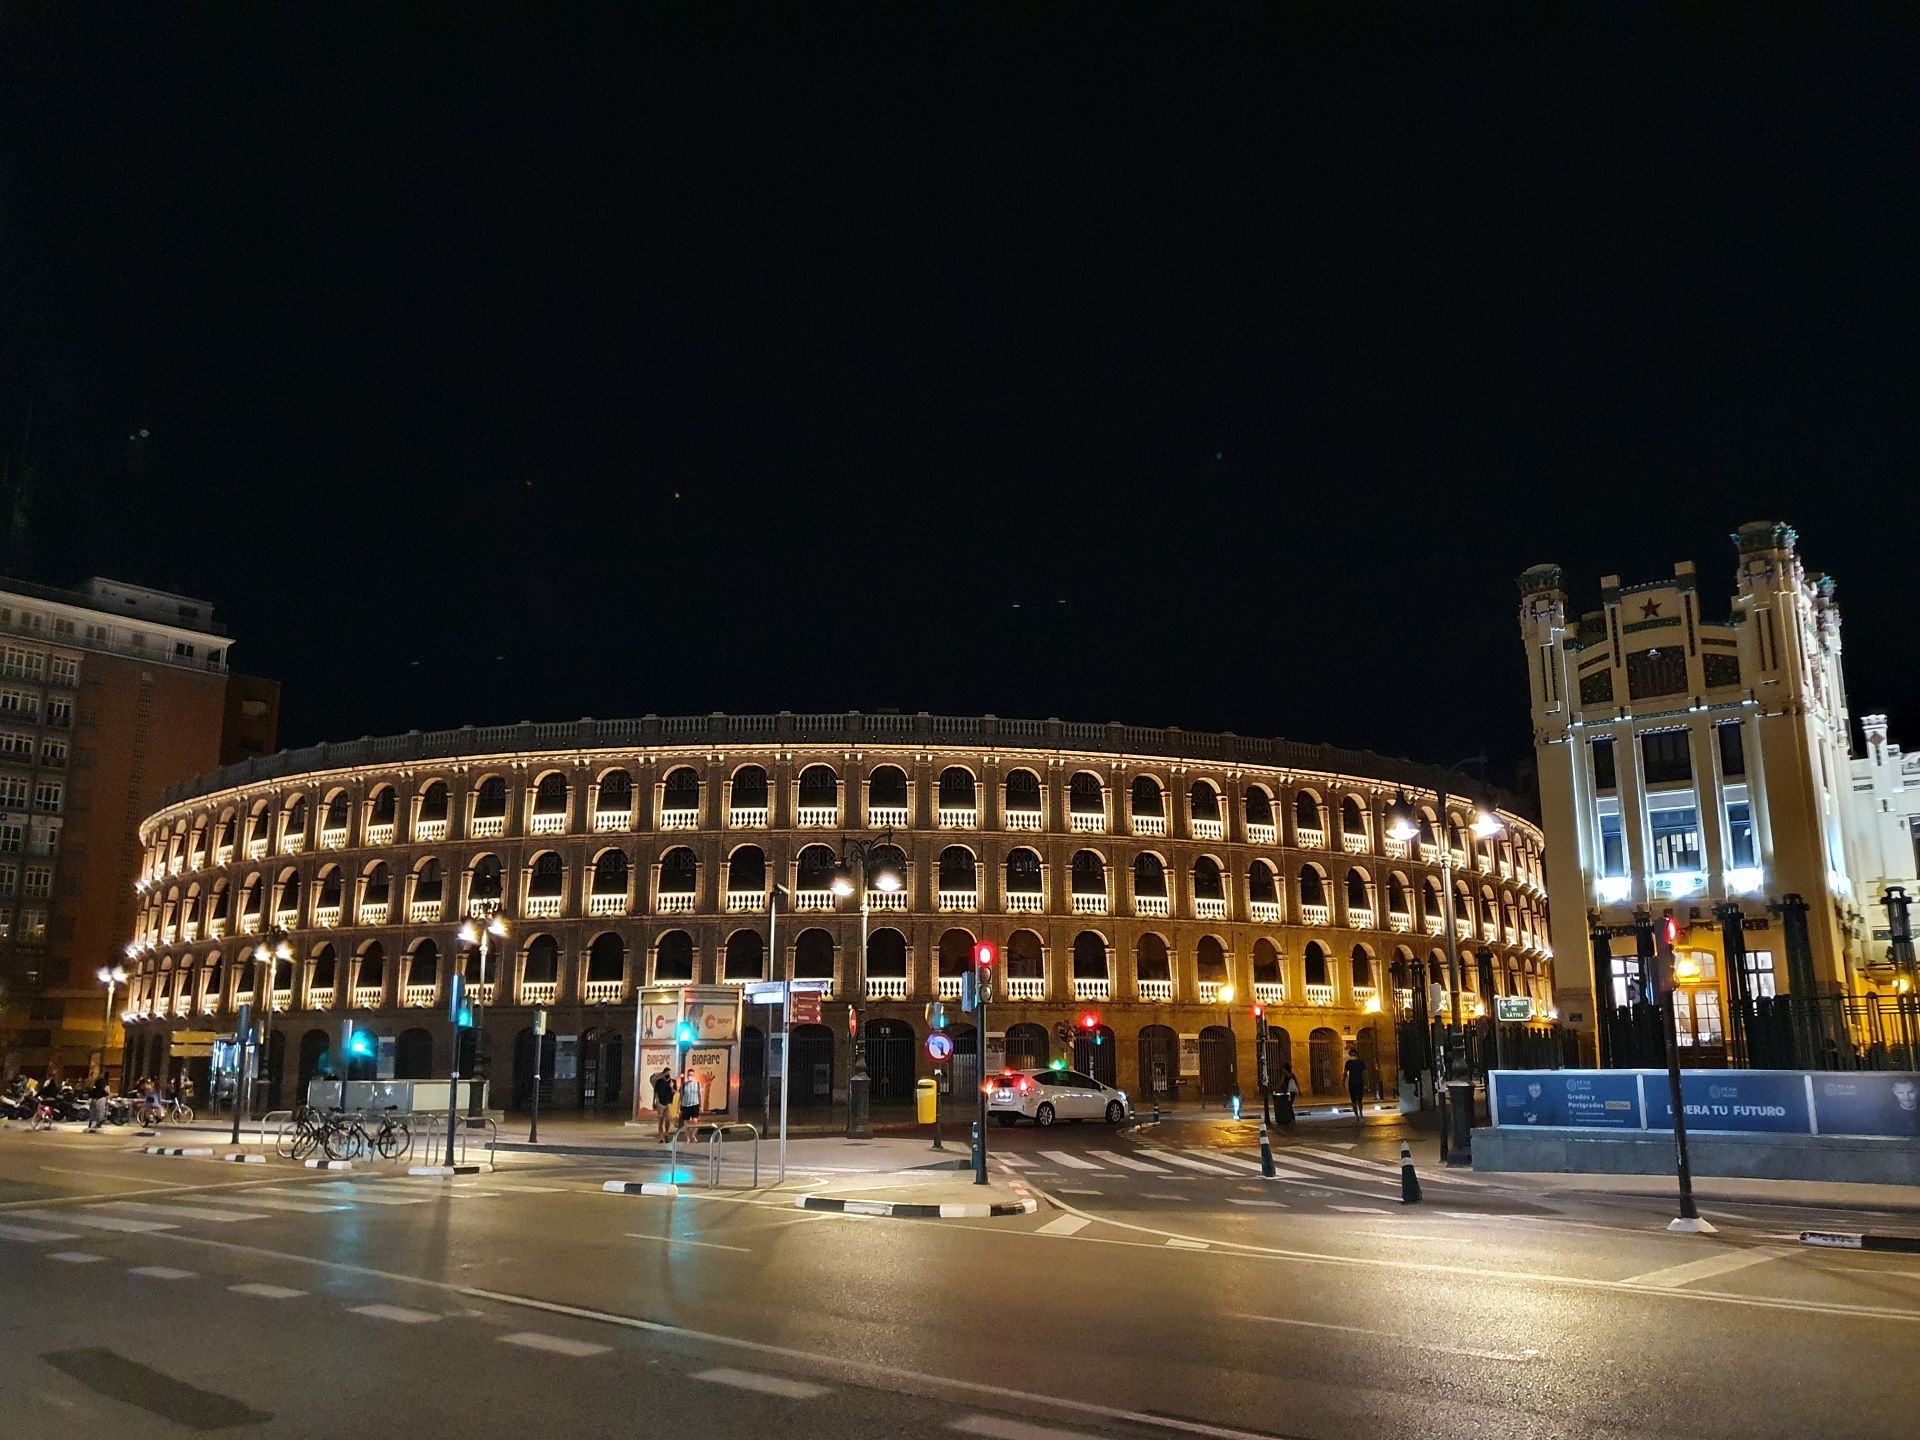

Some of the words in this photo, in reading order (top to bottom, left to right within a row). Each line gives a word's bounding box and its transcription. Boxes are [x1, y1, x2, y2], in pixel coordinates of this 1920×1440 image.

[1667, 1105, 1710, 1115] LERA
[1711, 1105, 1729, 1116] TU
[1733, 1106, 1786, 1116] FUTURO
